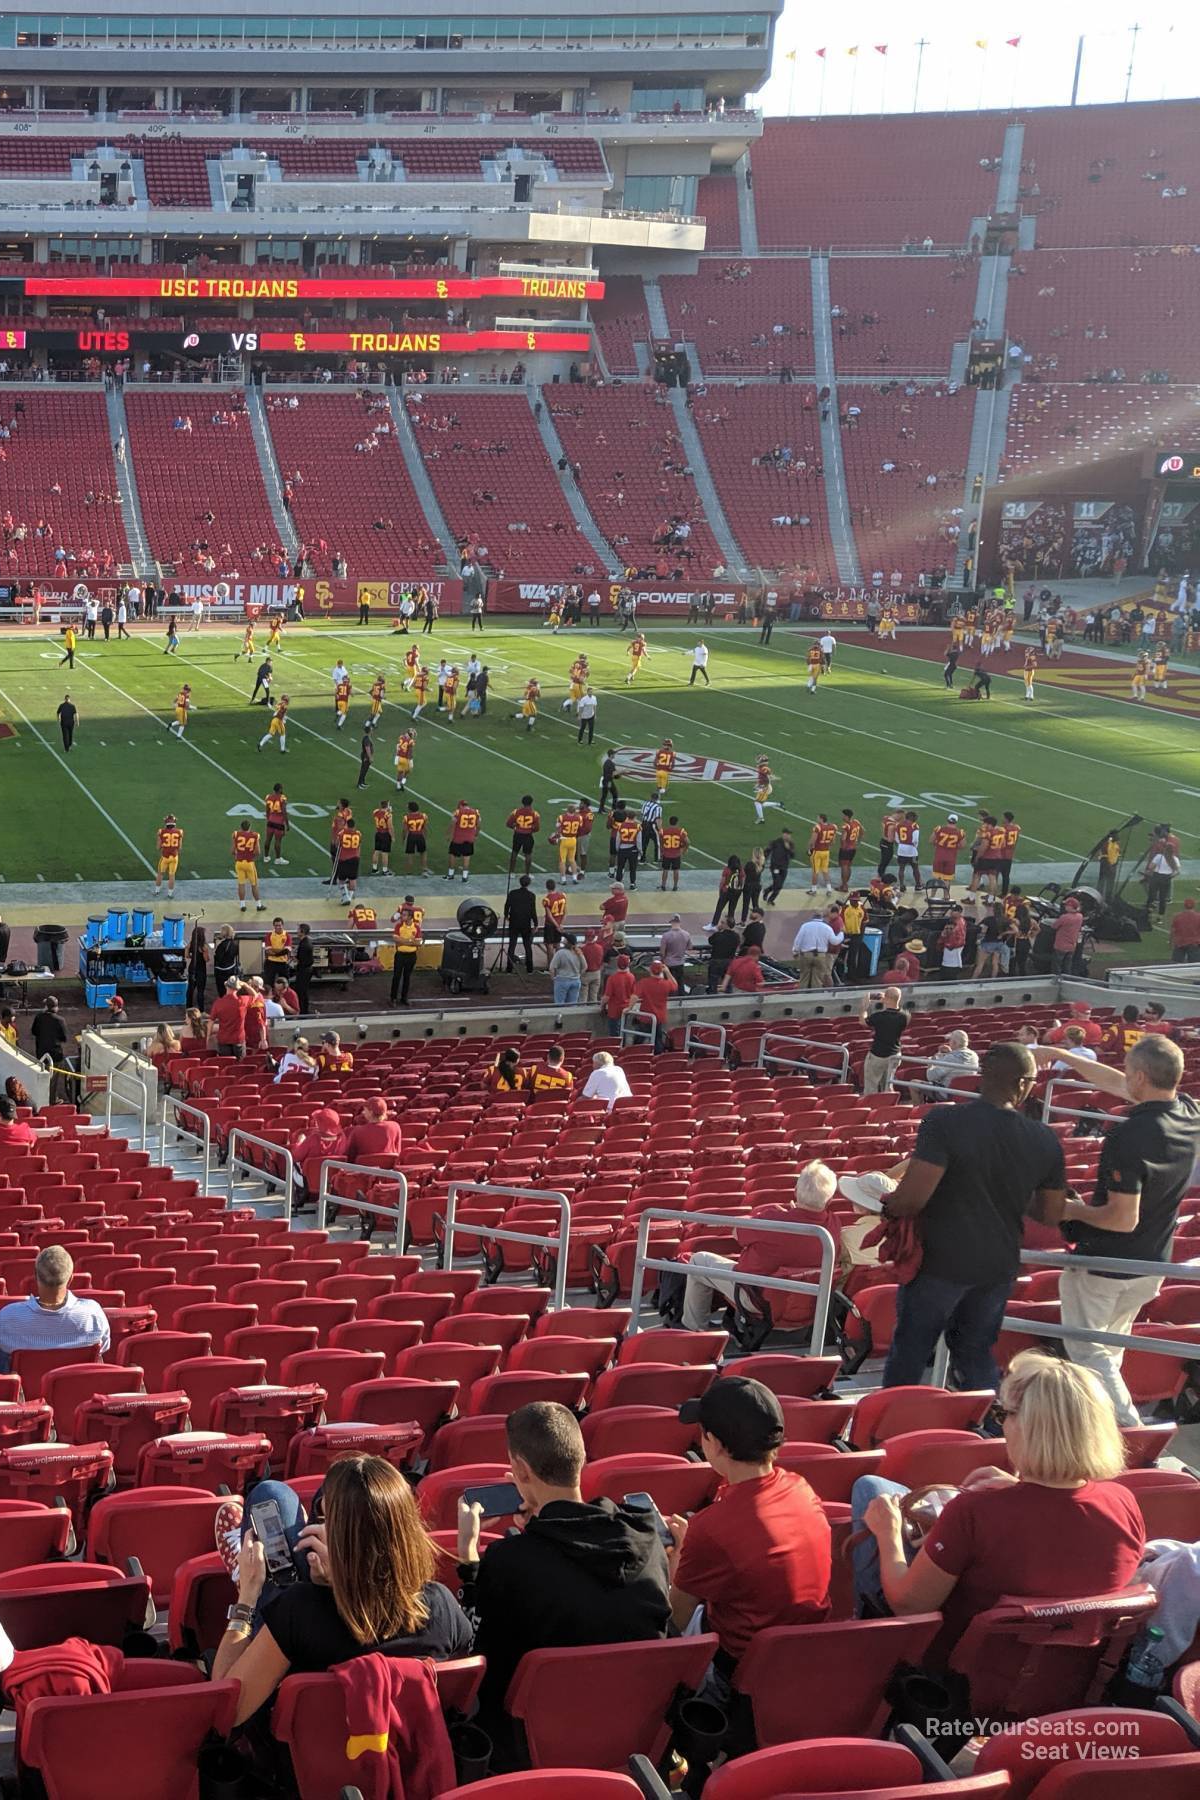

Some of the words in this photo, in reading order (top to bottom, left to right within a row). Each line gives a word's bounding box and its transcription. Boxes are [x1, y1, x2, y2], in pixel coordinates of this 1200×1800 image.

[161, 279, 199, 297] USC
[205, 279, 298, 298] TROJANS
[521, 278, 586, 299] TROJANS
[79, 332, 130, 351] UTES
[231, 333, 257, 350] VS
[350, 333, 441, 352] TROJANS
[1005, 502, 1026, 517] 34
[174, 584, 245, 605] USLE
[250, 584, 296, 605] MILK
[658, 753, 672, 766] 21
[408, 818, 425, 832] 37
[459, 814, 477, 829] 63
[516, 814, 533, 828] 42
[562, 820, 579, 834] 38
[162, 832, 179, 847] 36
[342, 833, 360, 849] 58
[620, 828, 638, 842] 27
[663, 834, 680, 849] 36
[938, 832, 958, 849] 72
[236, 837, 256, 851] 24
[356, 908, 375, 922] 59
[551, 900, 566, 917] 47
